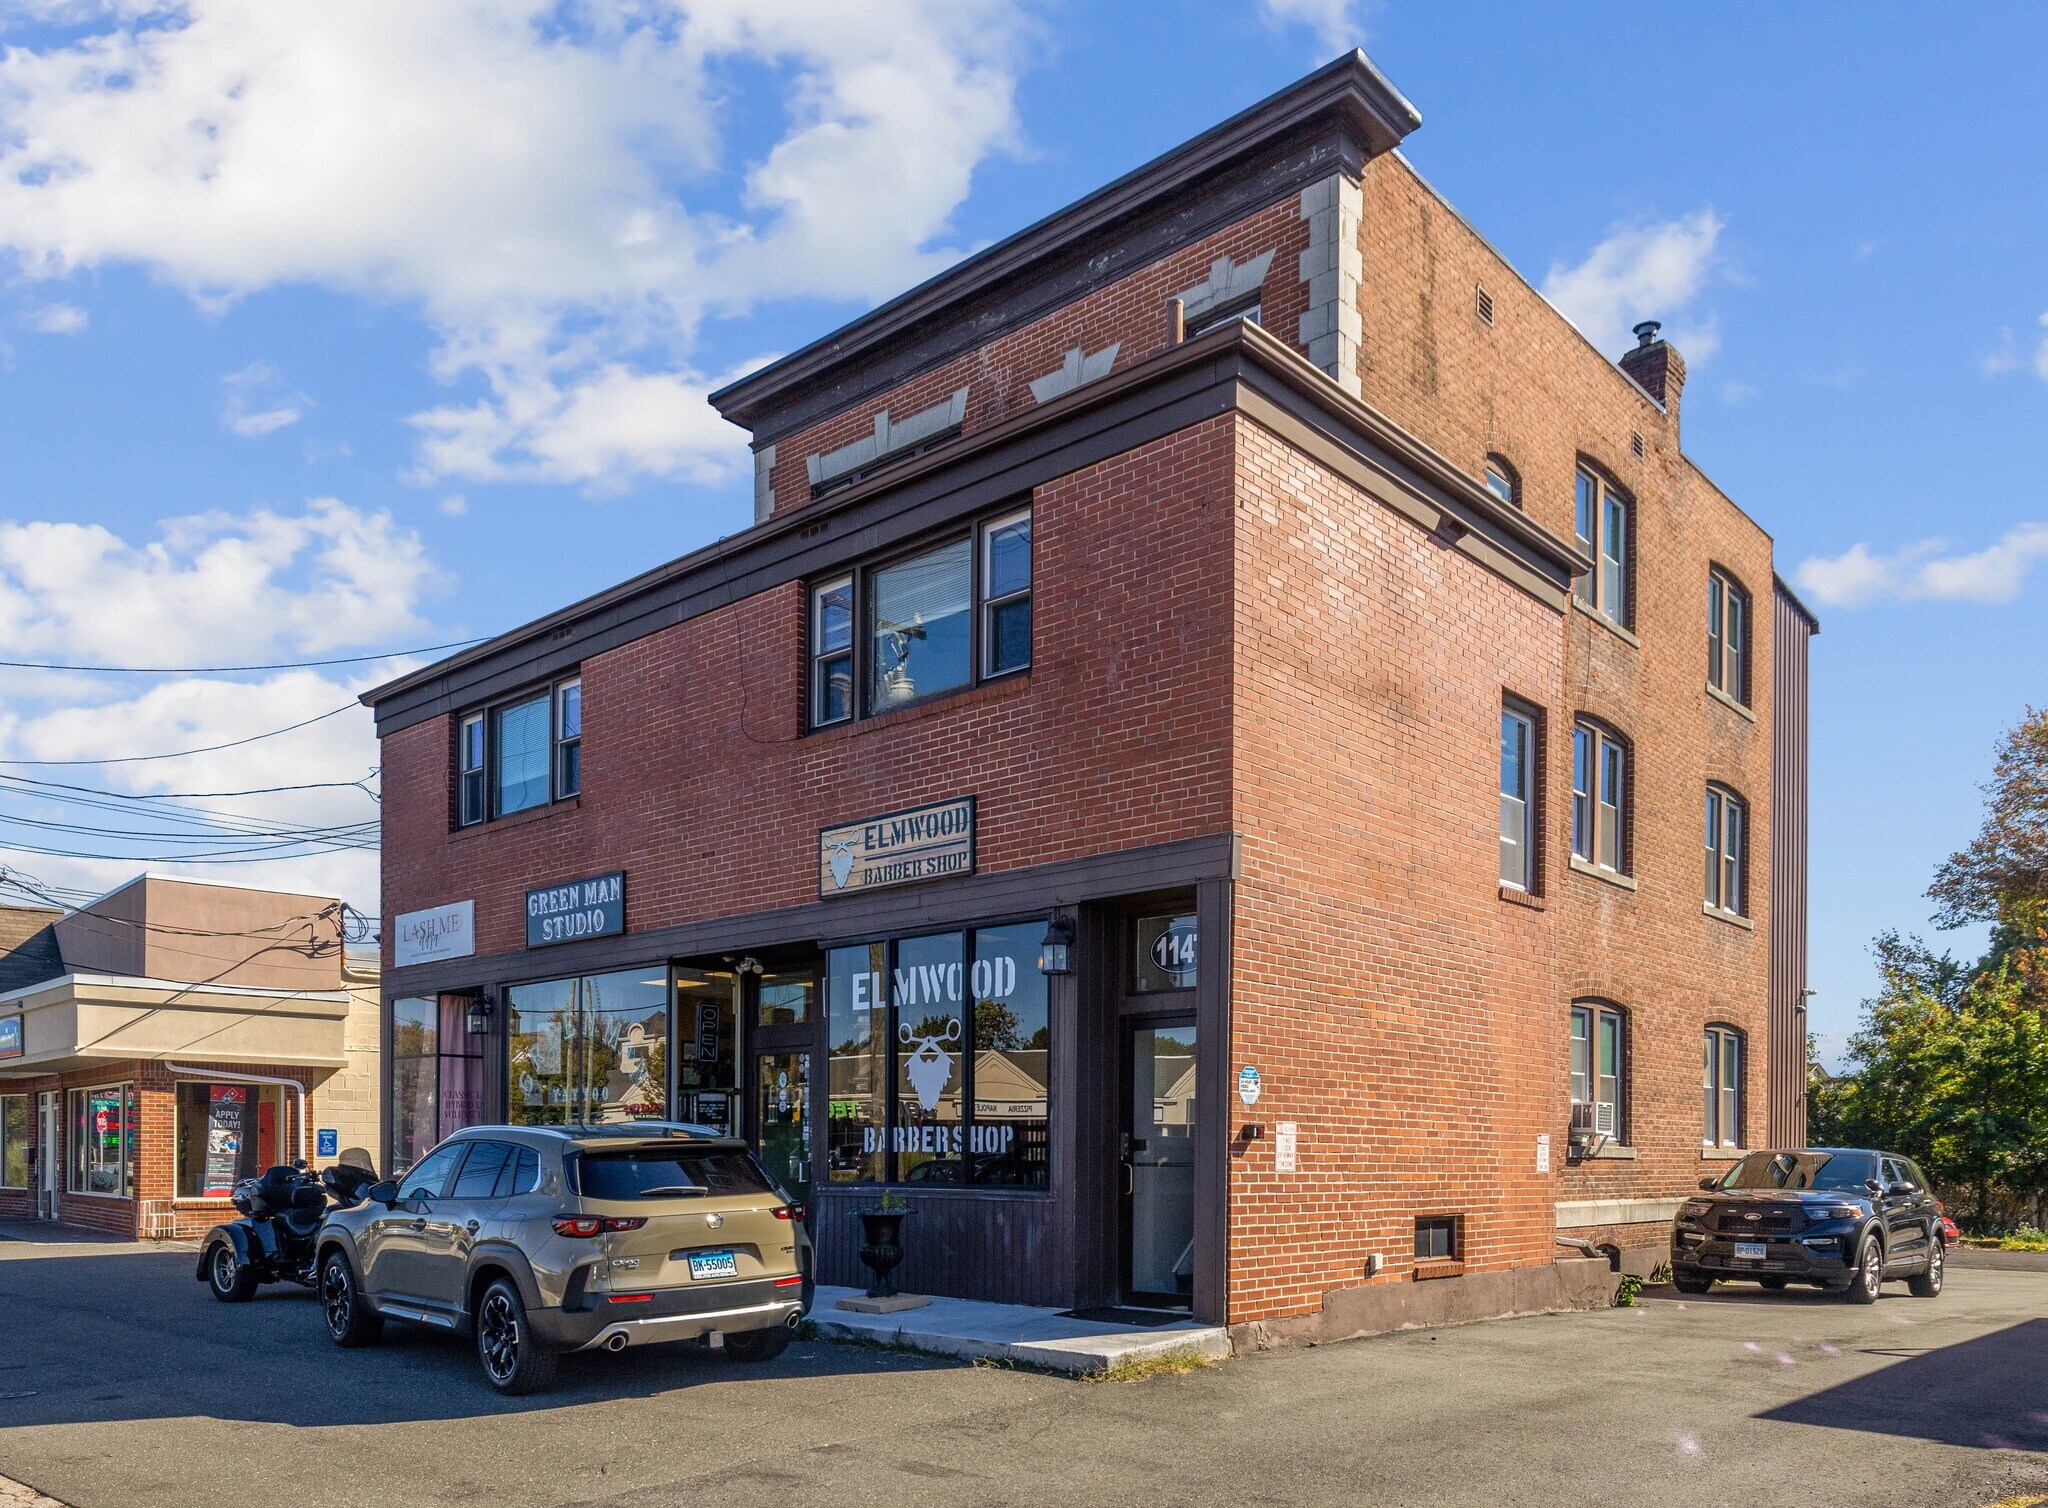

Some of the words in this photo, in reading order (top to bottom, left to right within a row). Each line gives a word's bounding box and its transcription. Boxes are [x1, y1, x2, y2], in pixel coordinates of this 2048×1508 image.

[865, 806, 968, 850] ELMWOOD
[865, 859, 922, 885] BARBER
[926, 851, 967, 874] SHOP
[528, 885, 579, 916] GREEN
[584, 877, 620, 906] MAN
[403, 918, 435, 942] LASH
[440, 914, 460, 935] ME
[542, 909, 605, 940] STUDIO
[852, 956, 1016, 1011] ELMWOOD
[701, 1008, 716, 1058] OPEN
[213, 1119, 241, 1129] TODAY!
[215, 1110, 240, 1120] APPLY
[692, 1257, 734, 1272] BK-55005
